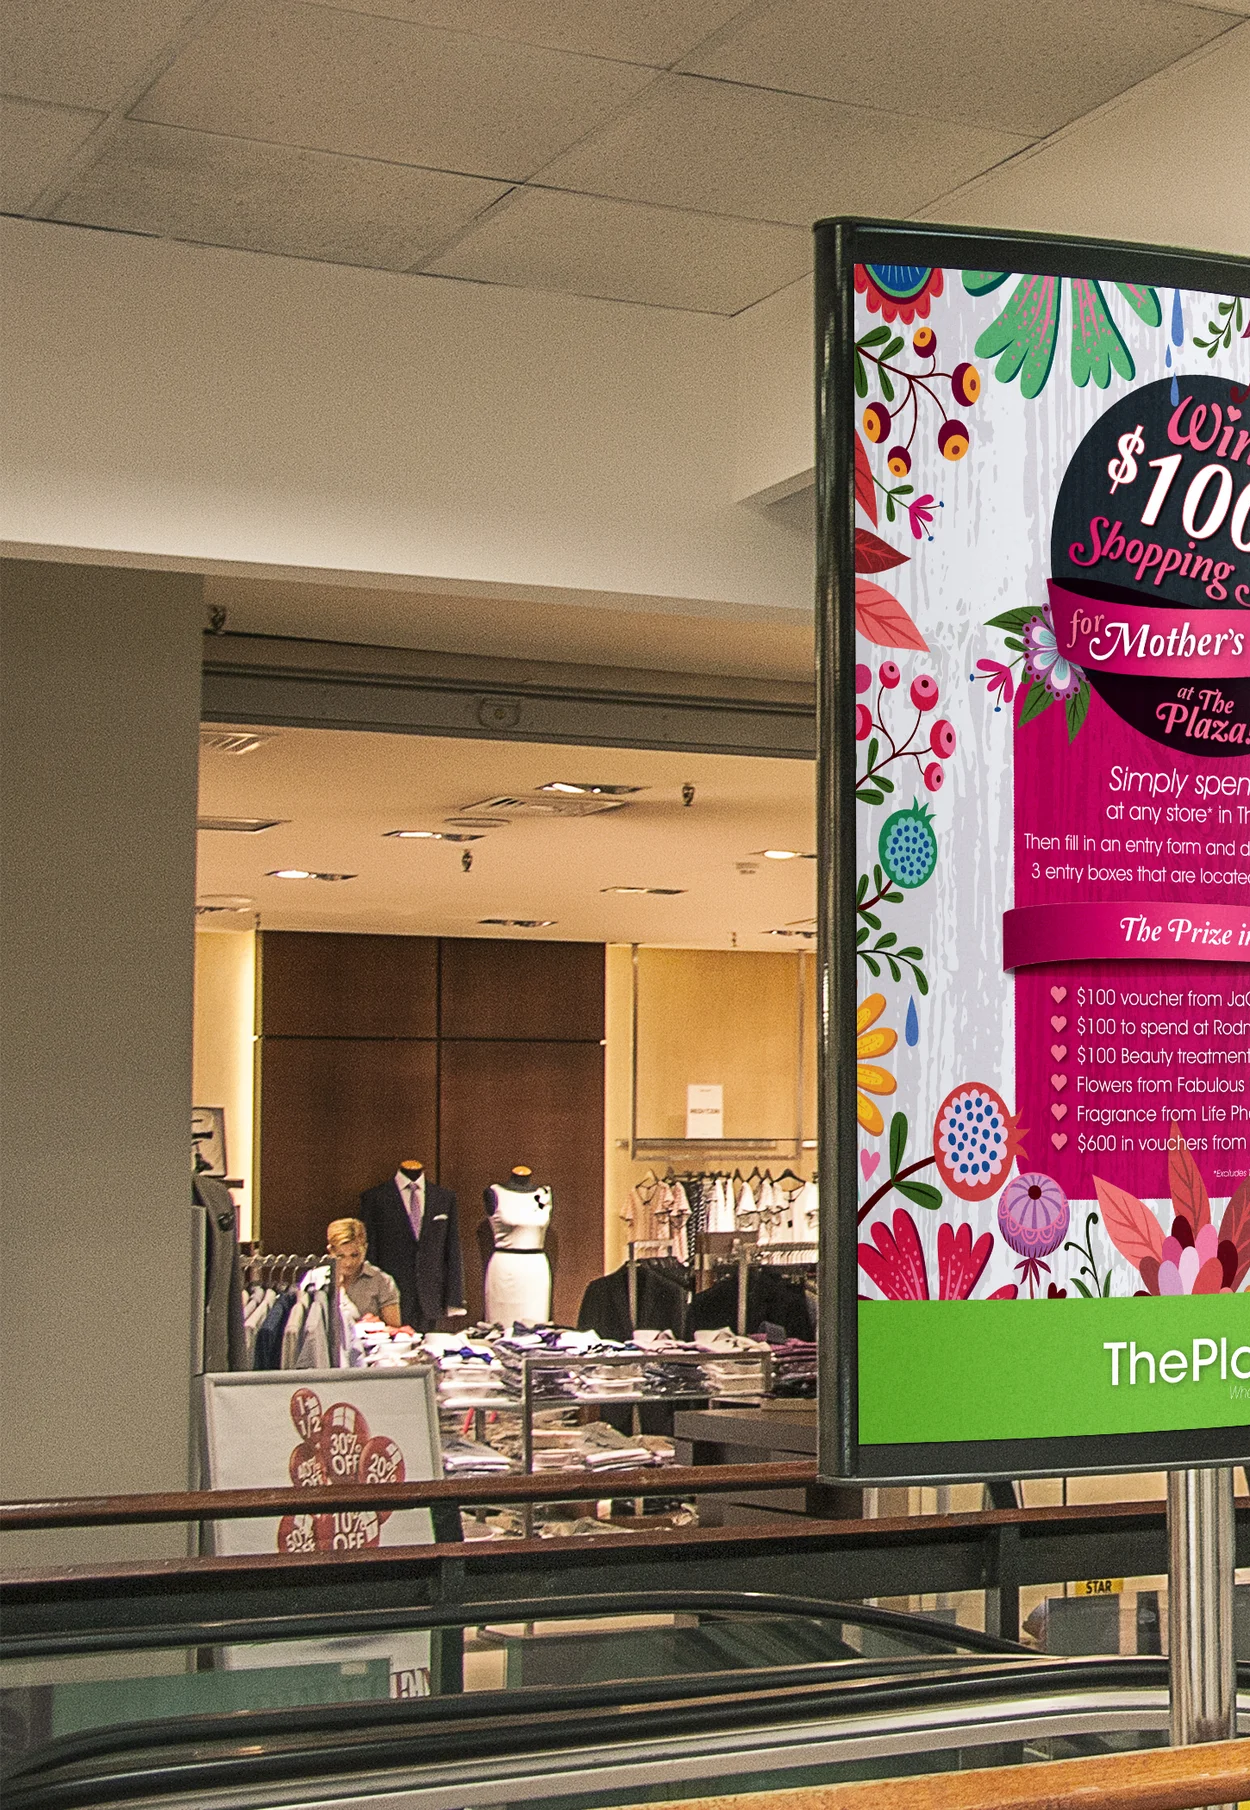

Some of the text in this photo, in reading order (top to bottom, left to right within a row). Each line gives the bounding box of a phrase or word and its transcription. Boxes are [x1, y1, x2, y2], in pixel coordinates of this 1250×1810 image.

[1068, 516, 1236, 601] Shopping
[1066, 608, 1105, 648] for
[1089, 622, 1245, 661] Mother's
[1176, 686, 1235, 715] at The
[1108, 765, 1189, 799] Simply
[1106, 801, 1125, 820] at
[1129, 805, 1162, 825] any
[1218, 805, 1233, 824] in
[1023, 832, 1061, 850] Then
[1064, 834, 1079, 851] fill
[1083, 834, 1096, 851] in
[1100, 838, 1121, 852] an
[1125, 837, 1163, 857] entry
[1166, 837, 1202, 855] form
[1205, 840, 1236, 857] and
[1031, 862, 1041, 879] 3
[1045, 863, 1084, 883] entry
[1087, 864, 1133, 882] boxes
[1136, 865, 1167, 883] that
[1170, 870, 1196, 884] are
[1119, 914, 1163, 943] The
[1167, 918, 1233, 946] Prize
[1076, 986, 1116, 1008] $100
[1120, 989, 1184, 1007] voucher
[1187, 989, 1223, 1007] from
[1077, 1015, 1116, 1037] $100
[1120, 1018, 1136, 1035] to
[1140, 1019, 1189, 1038] spend
[1193, 1019, 1210, 1036] at
[1077, 1044, 1117, 1066] $100
[1121, 1047, 1174, 1067] Beauty
[1077, 1075, 1133, 1093] Flowers
[1136, 1076, 1173, 1093] from
[1177, 1076, 1245, 1093] Fabulous
[1077, 1105, 1157, 1125] Fragrance
[1160, 1105, 1197, 1122] from
[1201, 1105, 1227, 1122] Life
[1077, 1132, 1117, 1153] $600
[1121, 1135, 1134, 1151] in
[1138, 1134, 1208, 1152] vouchers
[1212, 1134, 1247, 1151] from
[330, 1432, 362, 1455] 30%
[331, 1454, 360, 1475] OFF
[367, 1453, 397, 1484] 20%
[1086, 1580, 1112, 1595] STAR
